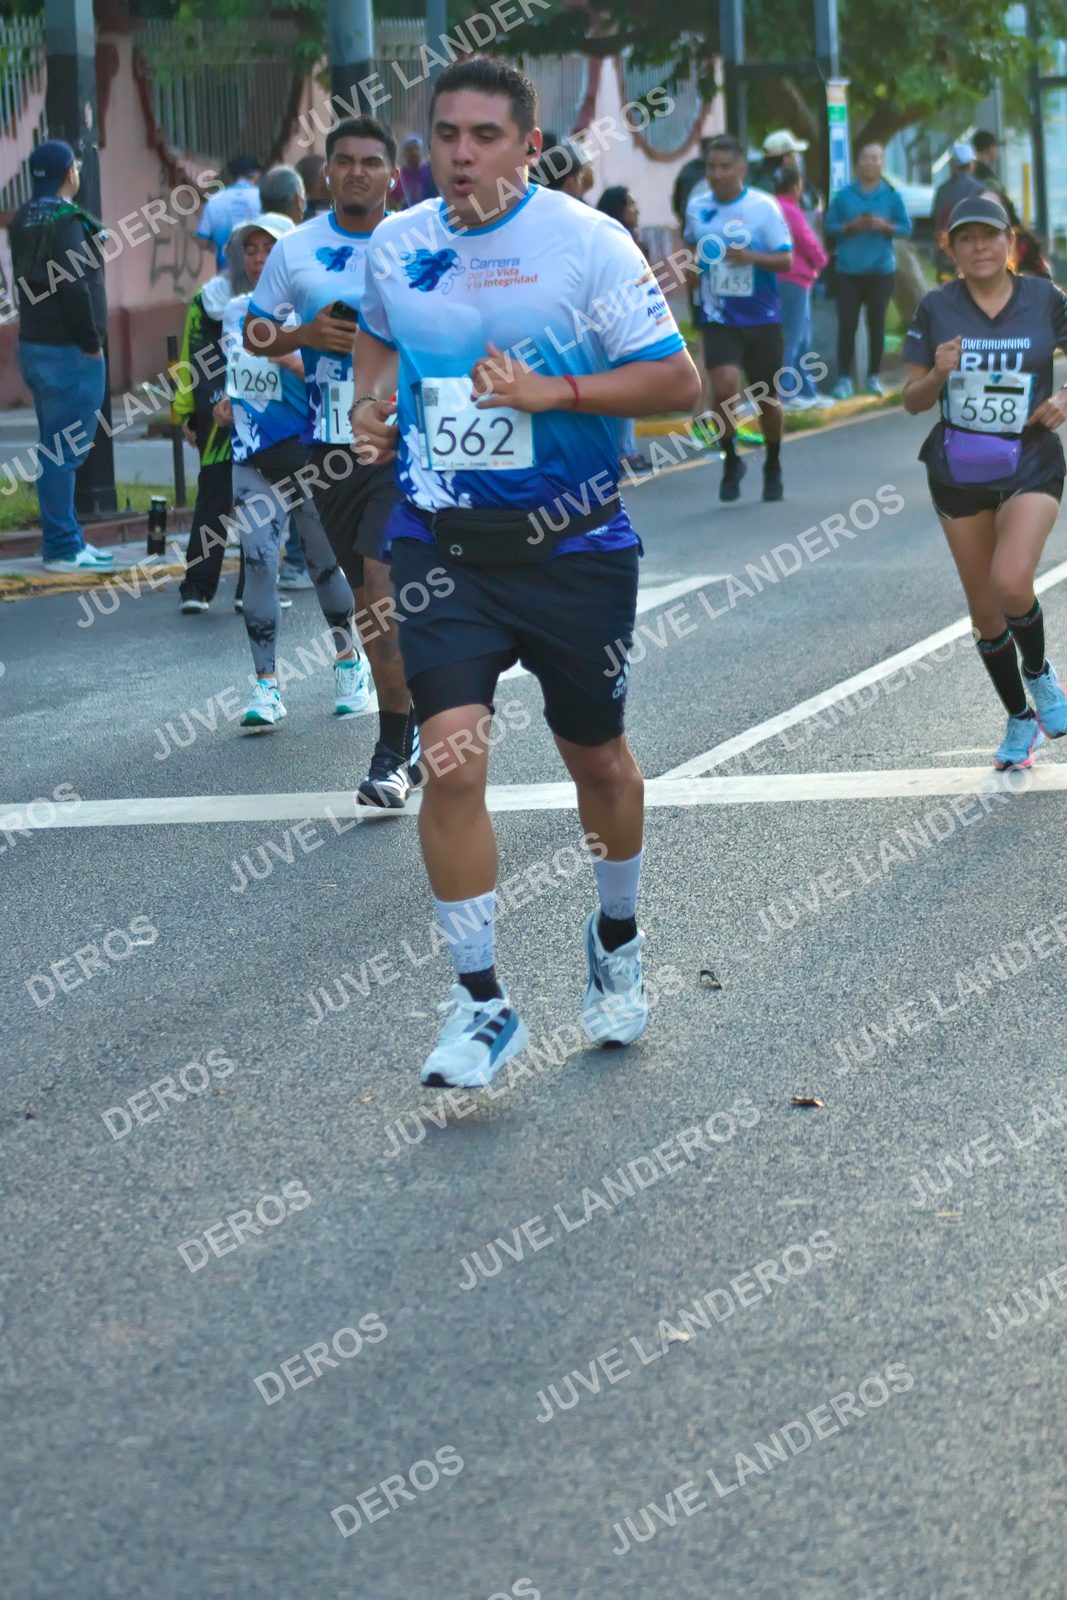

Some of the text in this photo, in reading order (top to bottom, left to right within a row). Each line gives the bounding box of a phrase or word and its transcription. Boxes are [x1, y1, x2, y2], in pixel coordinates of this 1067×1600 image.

[470, 257, 520, 270] Carrera
[497, 266, 519, 277] Vida
[961, 337, 1031, 351] OWERRUNNING
[231, 368, 279, 393] 1269
[960, 396, 1017, 425] 558
[432, 416, 514, 457] 562
